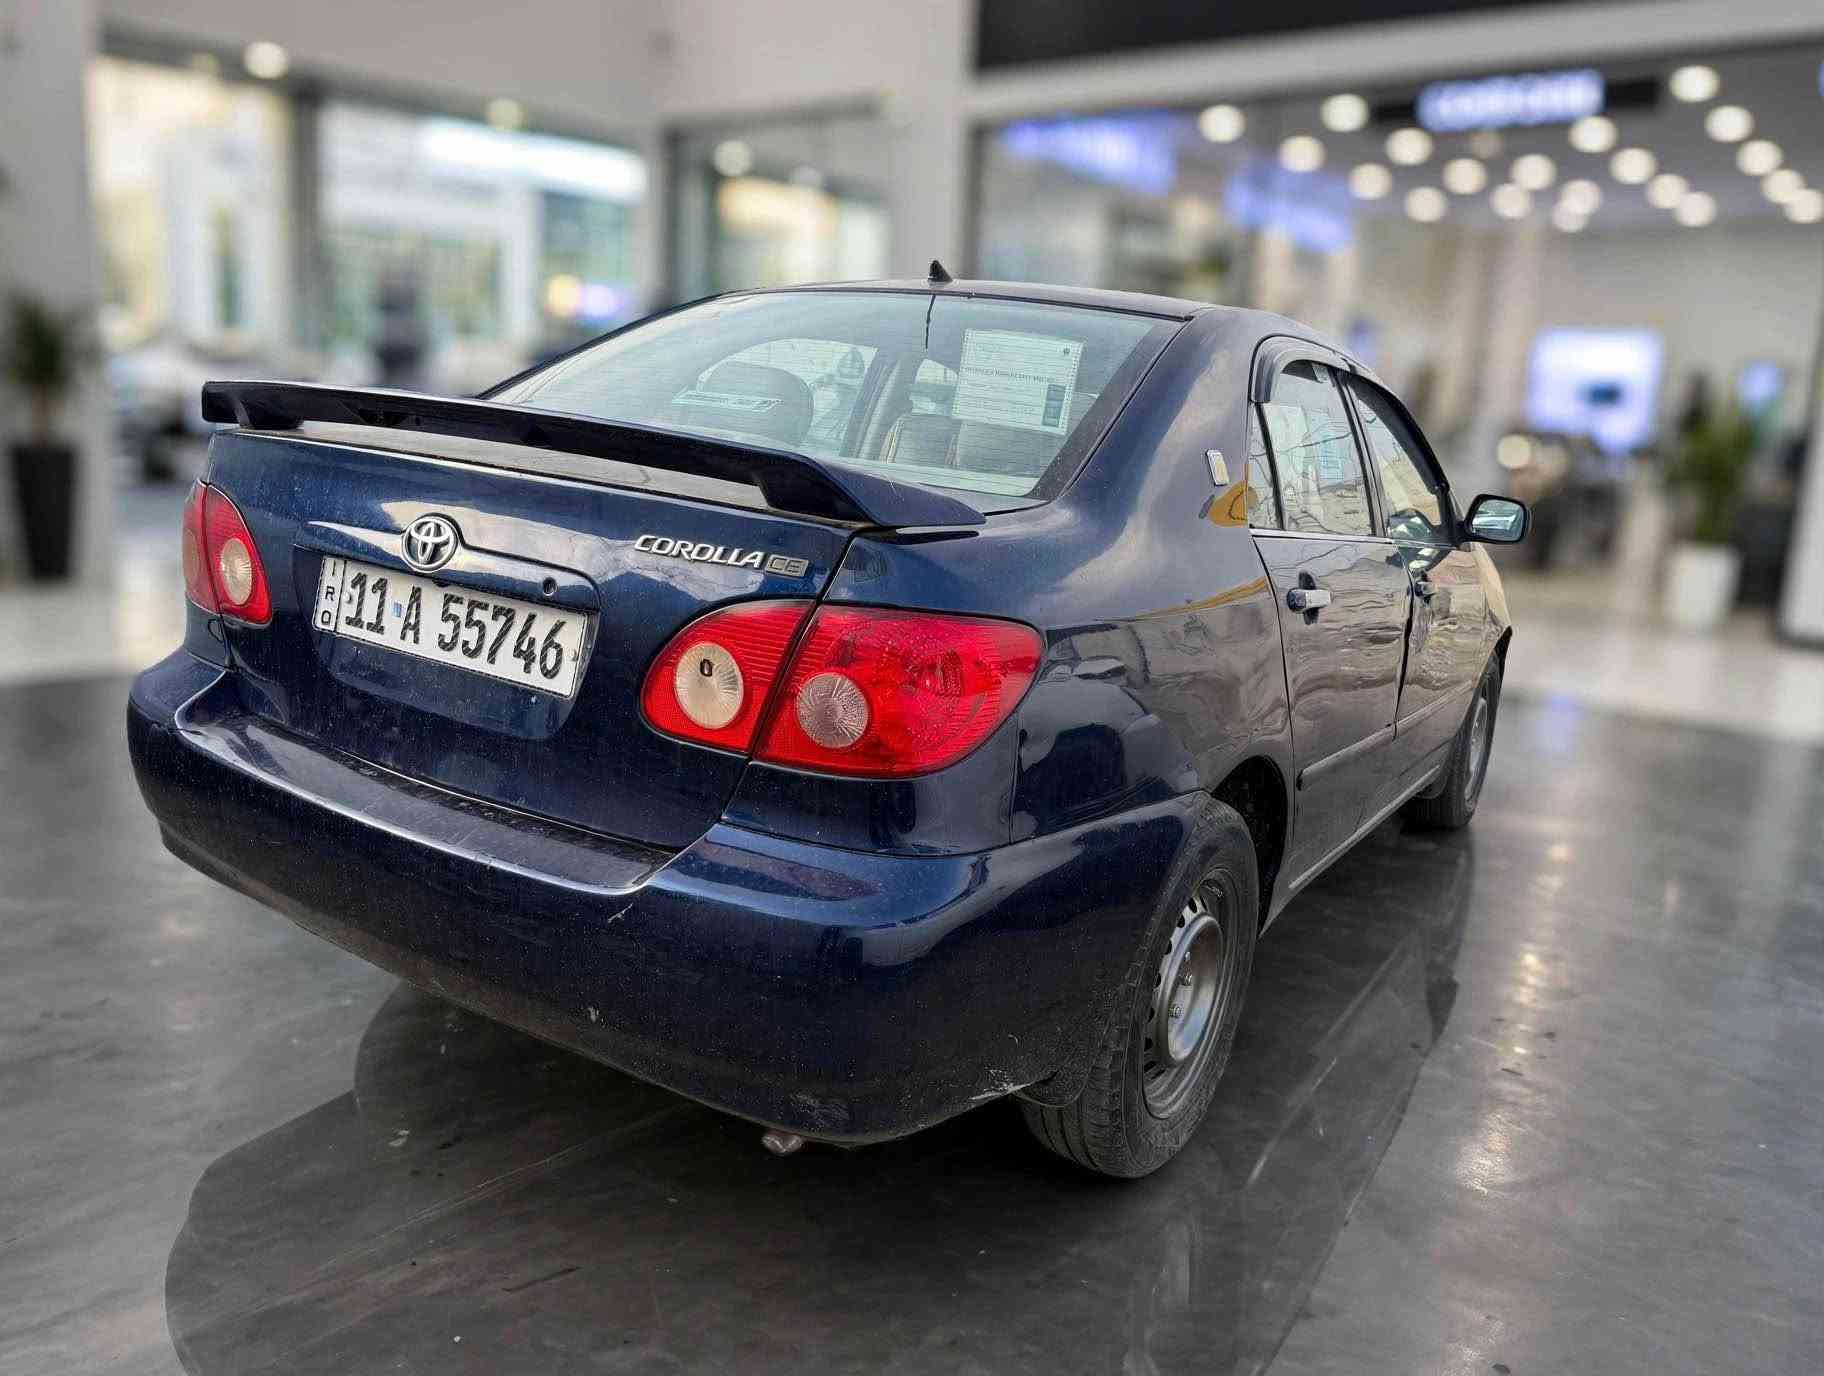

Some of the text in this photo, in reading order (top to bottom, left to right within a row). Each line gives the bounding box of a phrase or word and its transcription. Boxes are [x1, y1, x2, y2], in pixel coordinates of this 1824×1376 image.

[634, 534, 807, 576] COROLLA CE
[345, 572, 567, 680] 11 A 55746
